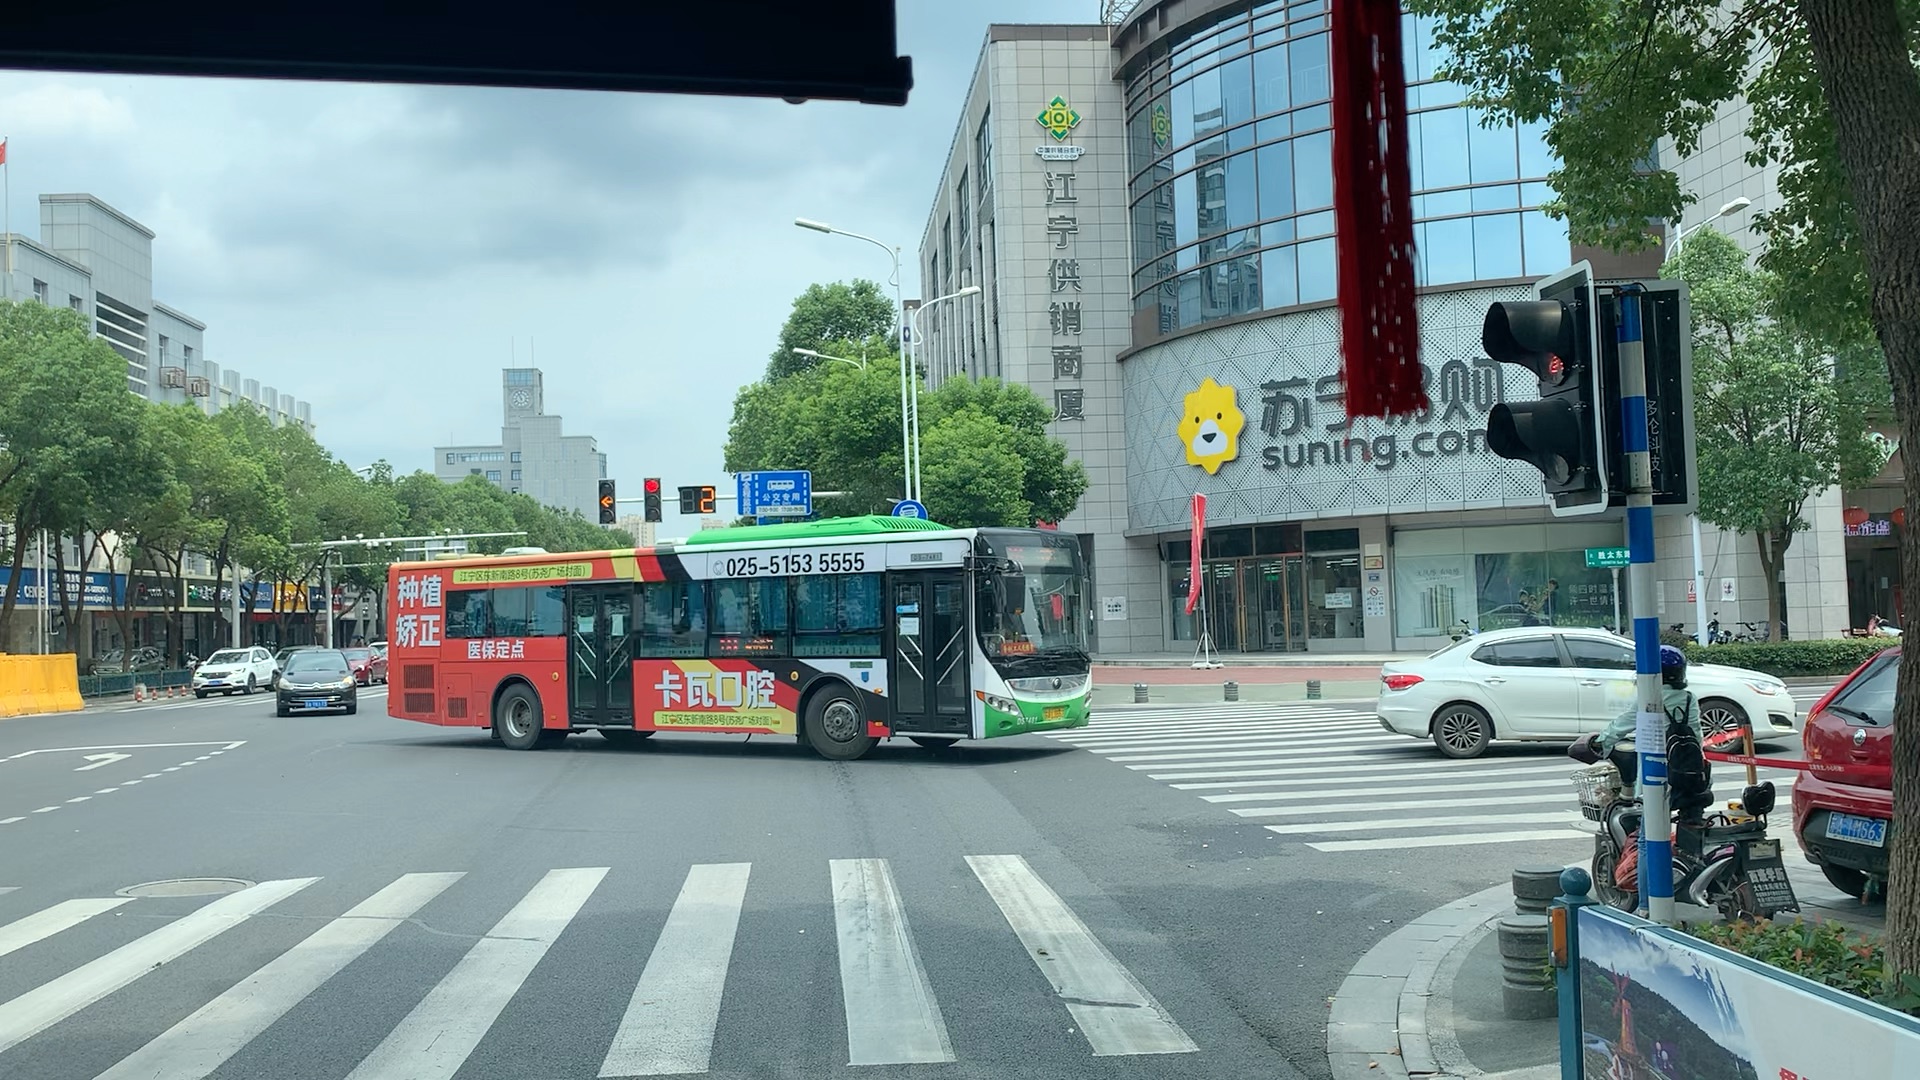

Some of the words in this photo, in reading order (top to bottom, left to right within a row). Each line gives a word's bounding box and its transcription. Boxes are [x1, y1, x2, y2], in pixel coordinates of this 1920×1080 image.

[1045, 172, 1086, 422] 江宁供销商厦
[701, 487, 715, 512] 2
[762, 492, 801, 502] 公交专用
[727, 554, 812, 576] 025-5153
[819, 552, 865, 572] 5555
[397, 574, 442, 608] 种植
[396, 613, 441, 648] 矫正
[468, 639, 525, 659] 医保定点
[654, 670, 778, 709] 卡瓦口腔
